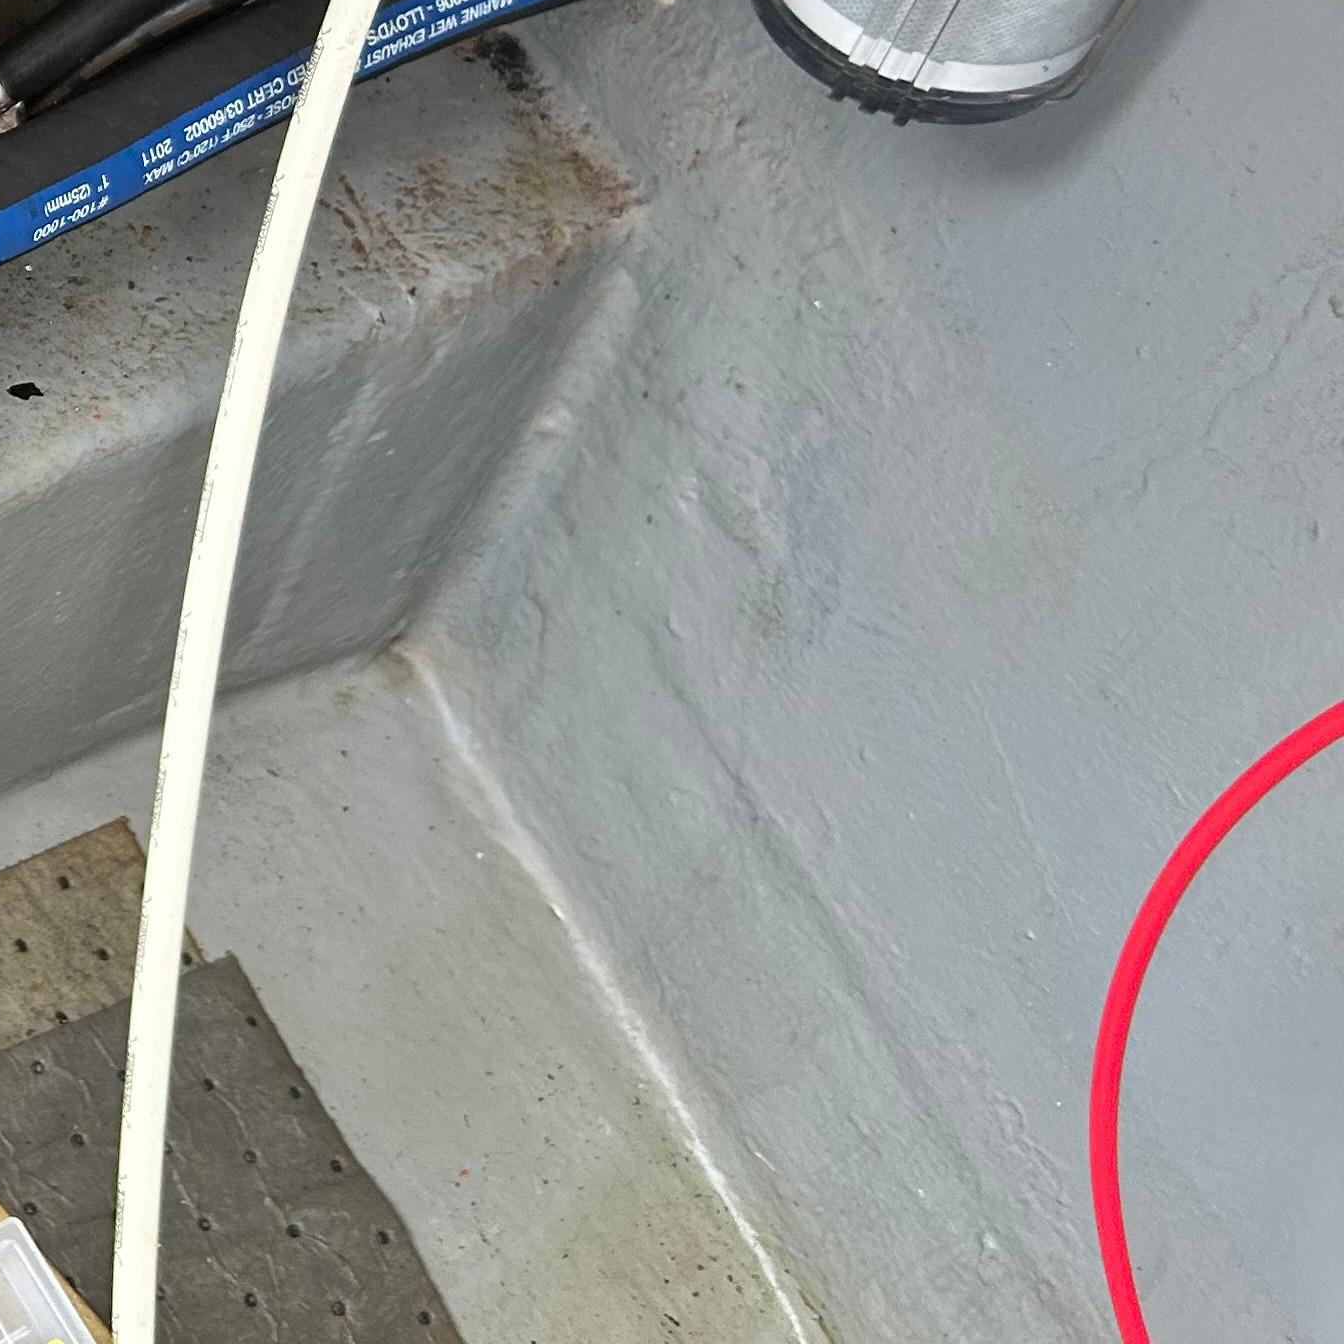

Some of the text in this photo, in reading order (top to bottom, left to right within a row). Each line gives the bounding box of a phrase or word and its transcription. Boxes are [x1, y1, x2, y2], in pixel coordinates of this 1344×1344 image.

[364, 4, 425, 46] LLOYD'S
[428, 14, 457, 36] WET
[363, 27, 427, 64] EXHAUST
[244, 75, 285, 109] CERT
[182, 98, 245, 142] 03/60002
[138, 137, 173, 166] 2011
[140, 159, 175, 184] MAX.
[41, 182, 92, 216] (25mm)
[30, 194, 111, 241] #100-1000
